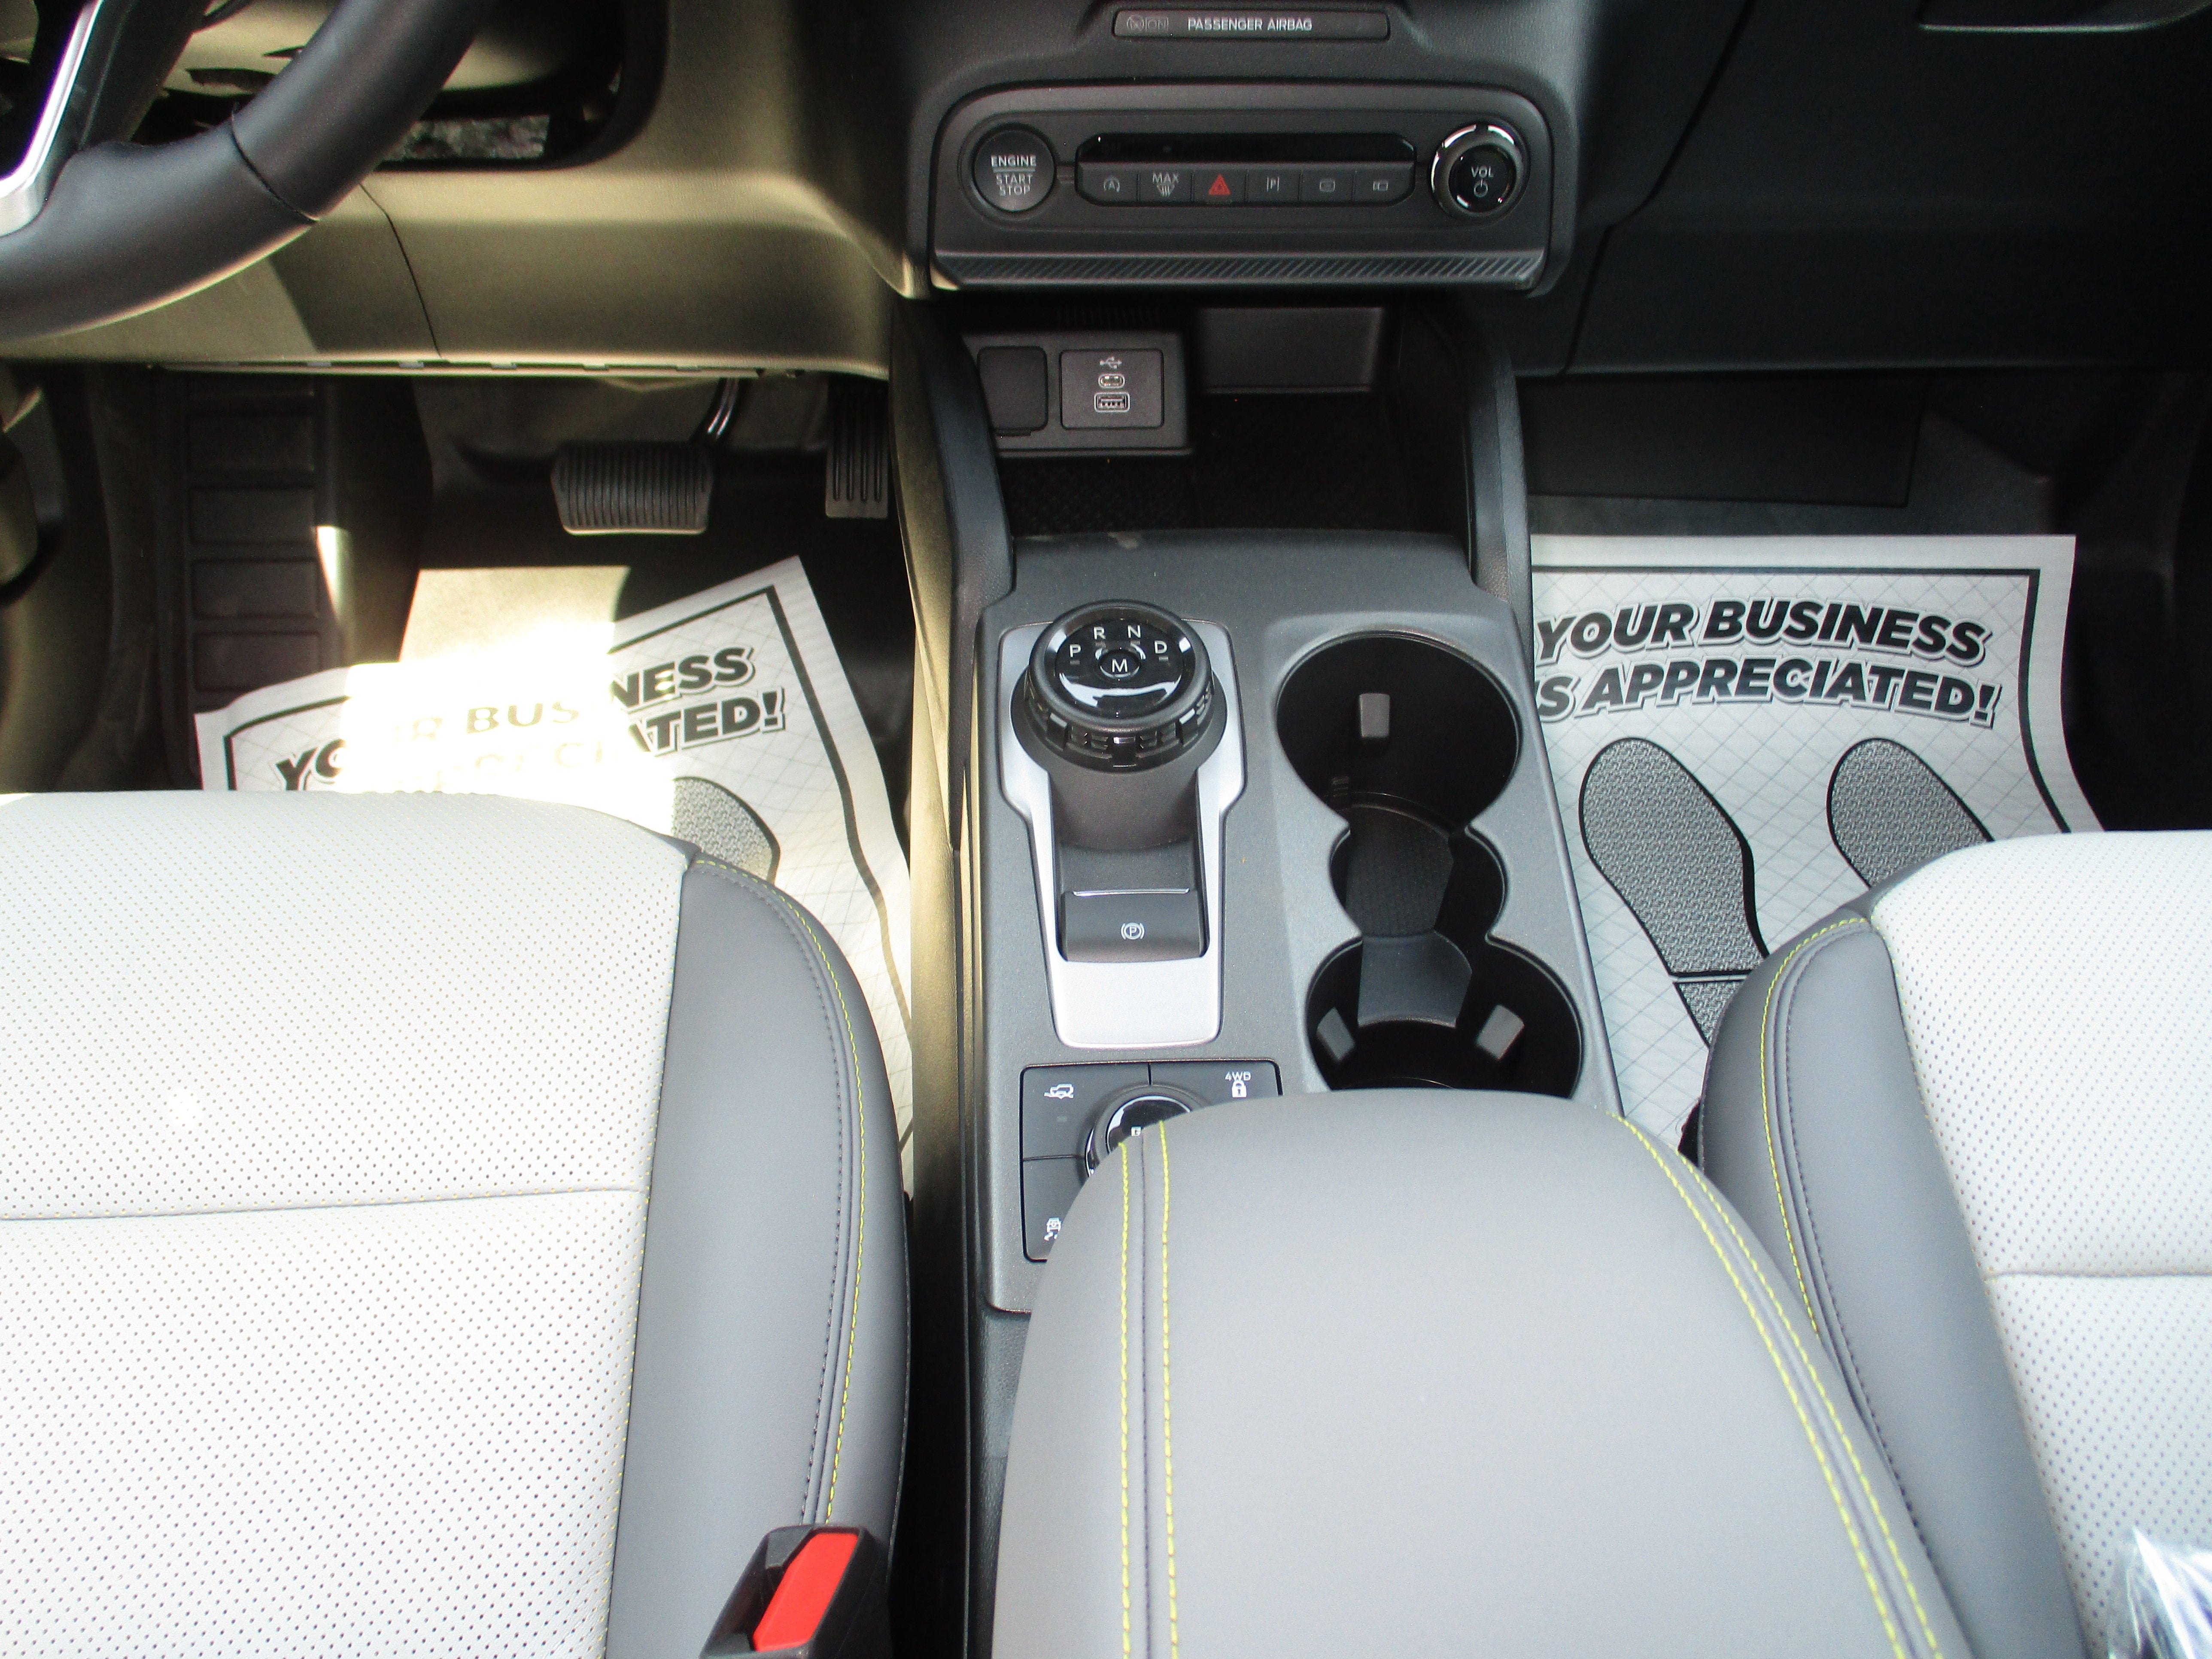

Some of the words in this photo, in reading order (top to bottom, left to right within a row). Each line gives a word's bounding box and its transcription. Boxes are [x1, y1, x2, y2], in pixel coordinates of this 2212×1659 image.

[1188, 18, 1263, 31] PASSENGER
[1267, 18, 1313, 31] AIRBAG
[991, 155, 1036, 167] ENGINE
[1152, 173, 1179, 183] MAX
[1471, 167, 1493, 178] VOL
[996, 173, 1033, 185] START
[1000, 184, 1030, 196] STOP
[1537, 603, 1697, 660] YOUR
[1702, 601, 1986, 663] BUSINESS
[1070, 645, 1081, 657] P
[1094, 627, 1106, 640] R
[1127, 625, 1141, 638] N
[1154, 641, 1167, 654] D
[1112, 659, 1129, 673] M
[467, 647, 749, 735] BUSNESS
[1535, 676, 1574, 716] S
[1582, 659, 1995, 720] APPRECIATED!
[1224, 1071, 1251, 1082] 4WD
